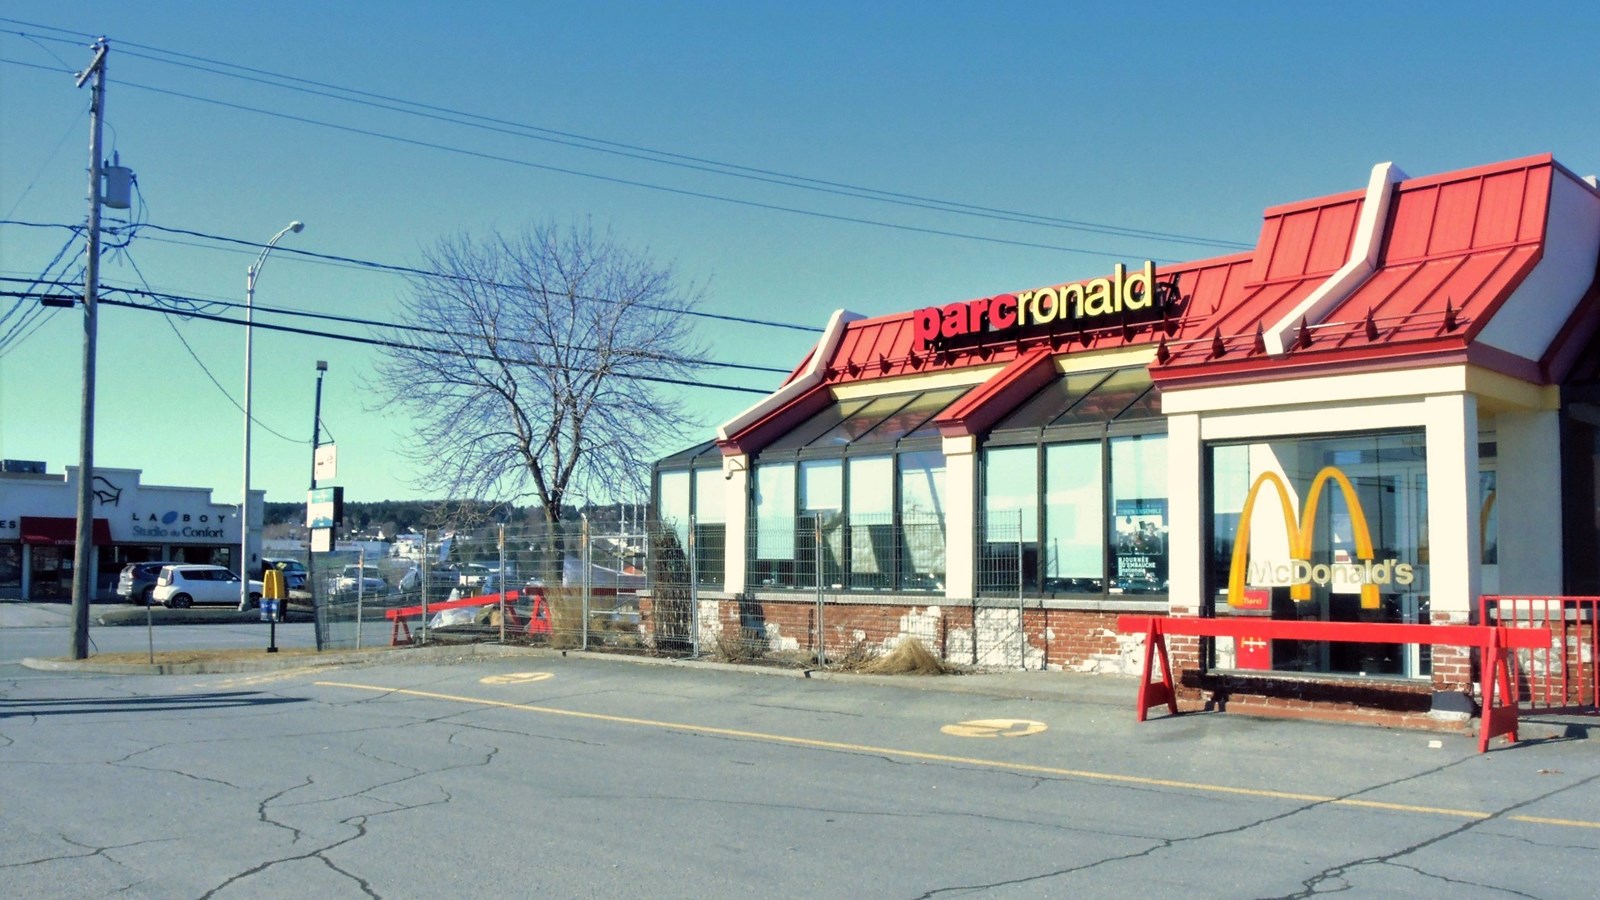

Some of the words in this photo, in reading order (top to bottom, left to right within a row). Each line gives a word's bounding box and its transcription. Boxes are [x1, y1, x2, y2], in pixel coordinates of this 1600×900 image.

[183, 513, 226, 523] BOY
[133, 525, 168, 537] Studio
[182, 526, 224, 538] Confort
[1247, 559, 1413, 585] McDonald's
